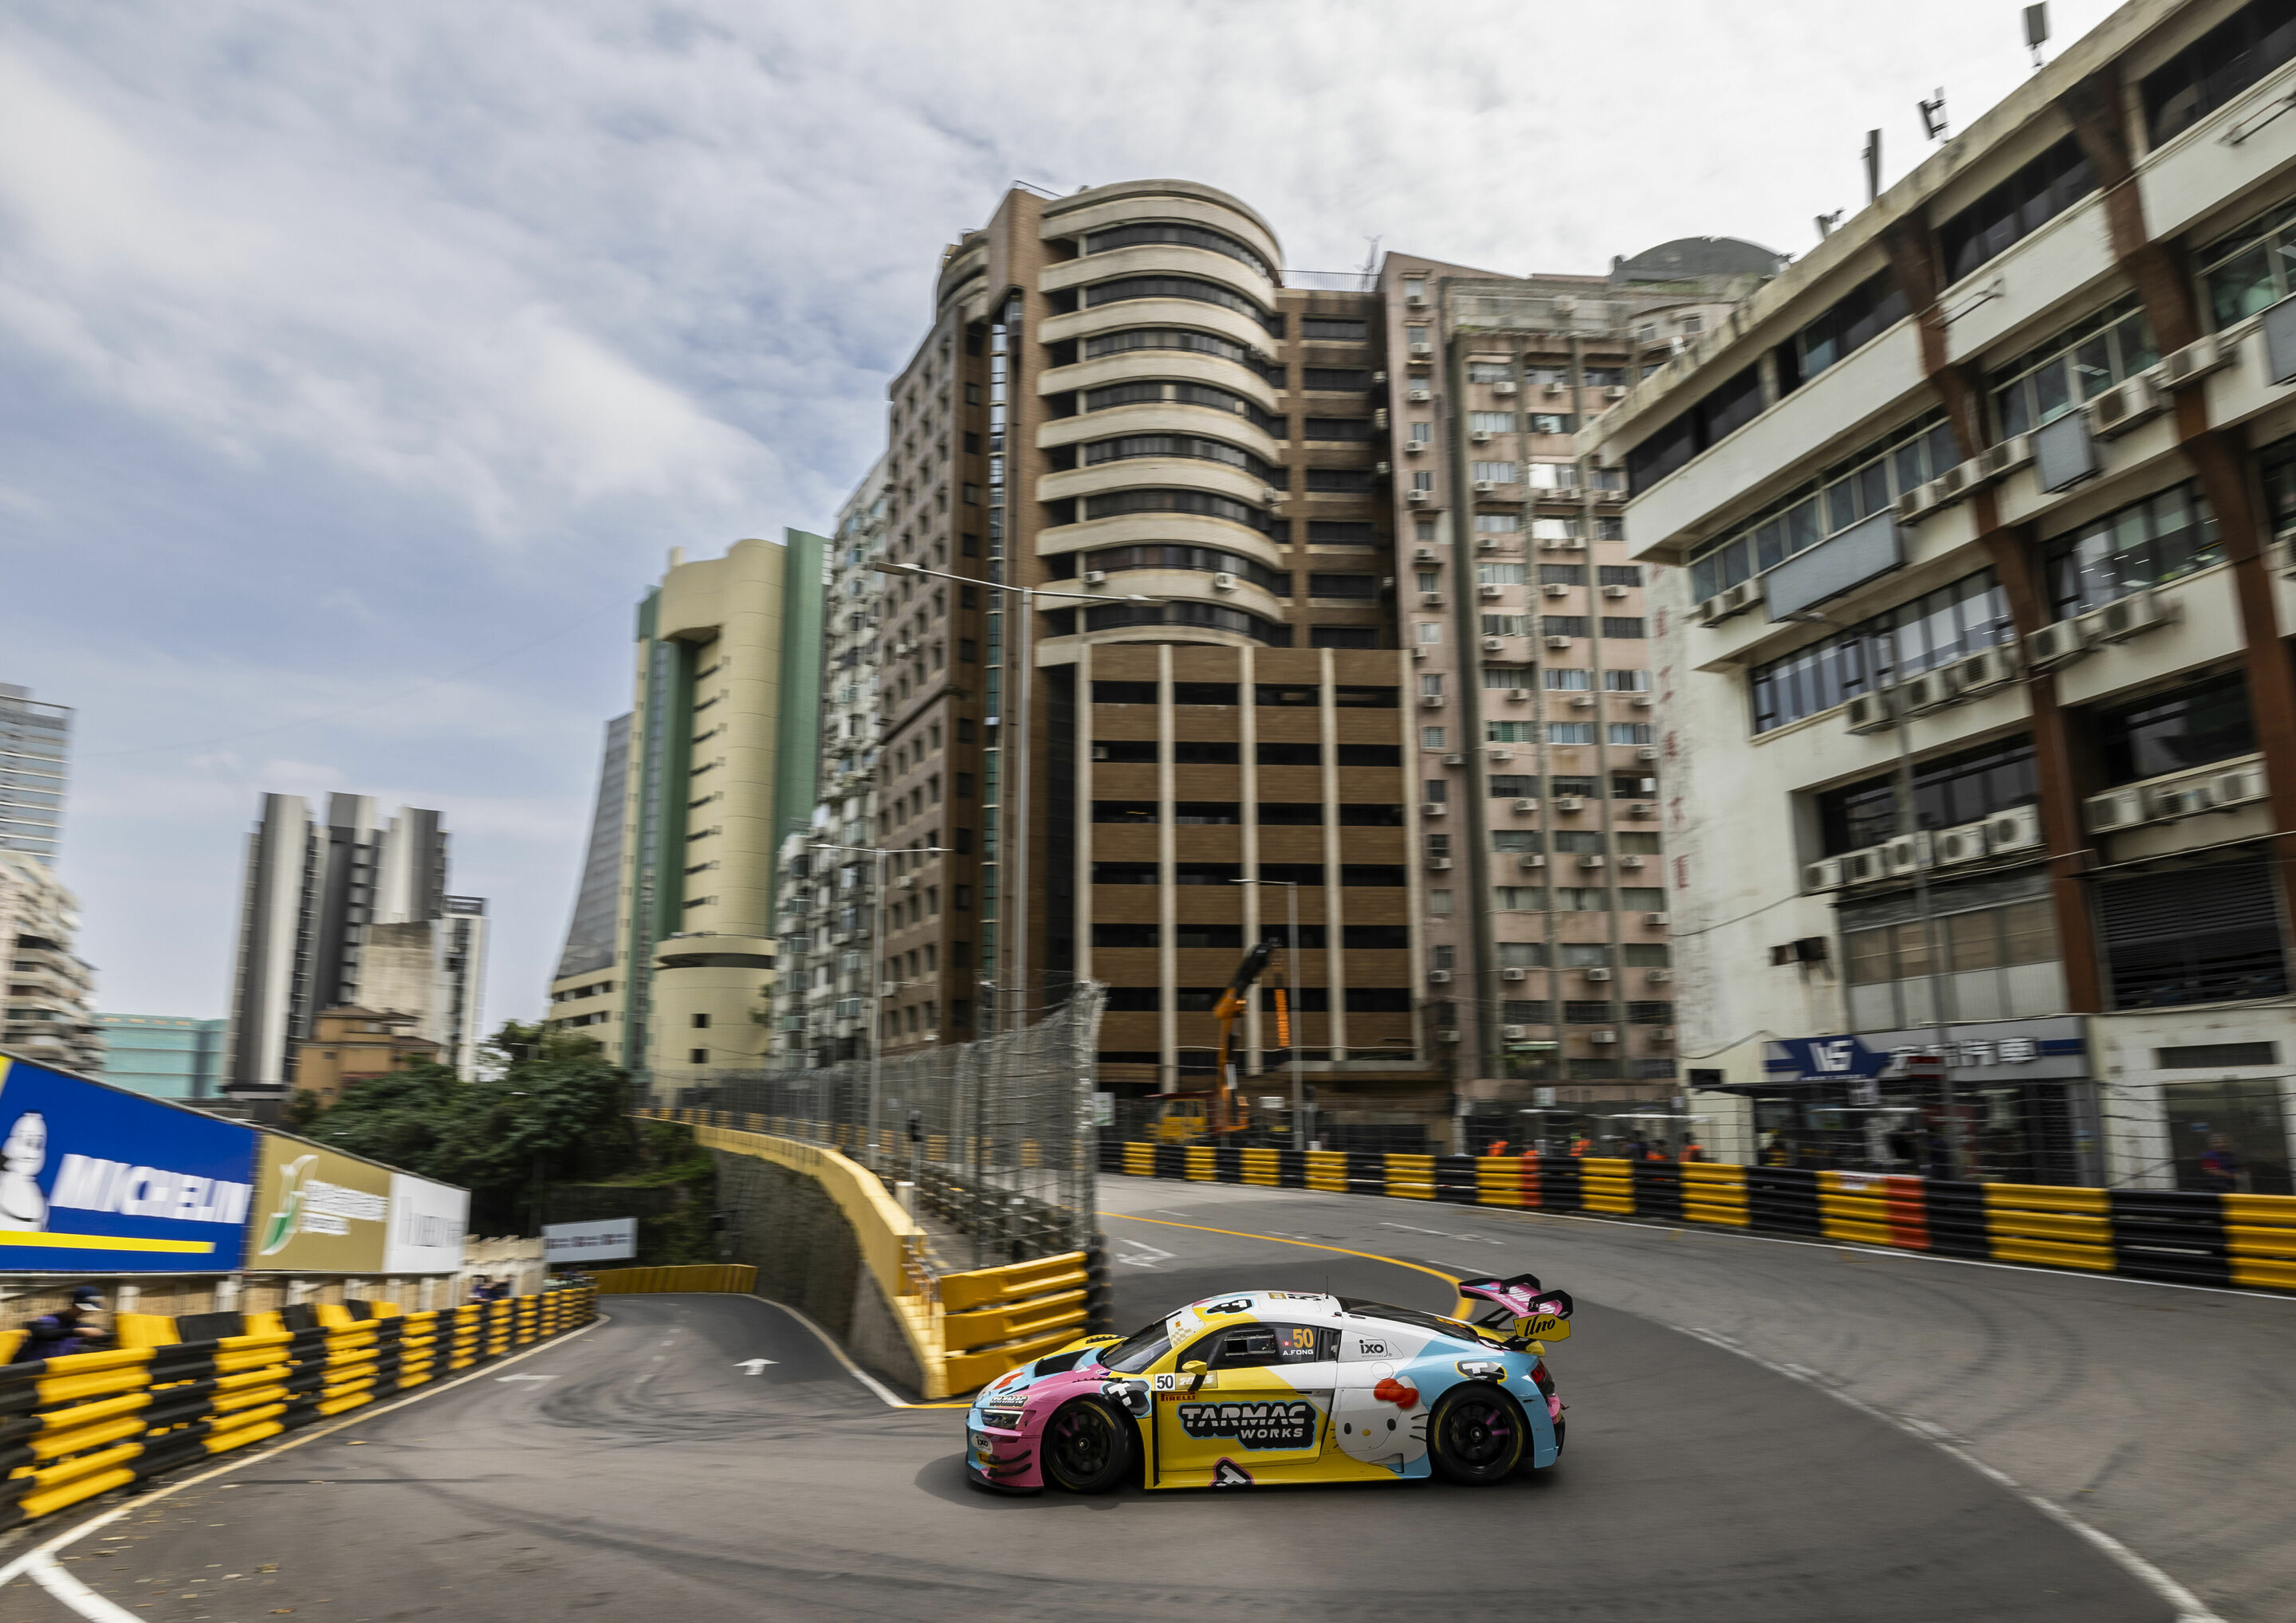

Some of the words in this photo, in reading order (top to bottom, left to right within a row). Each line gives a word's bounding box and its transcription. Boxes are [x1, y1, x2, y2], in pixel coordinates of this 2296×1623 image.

[49, 1153, 254, 1224] MICHELIN
[1292, 1328, 1314, 1348] 50
[1156, 1375, 1174, 1389] 50
[1161, 1392, 1196, 1401] PIRELLI
[1181, 1405, 1307, 1428] TARMAC
[1240, 1428, 1303, 1439] WORKS
